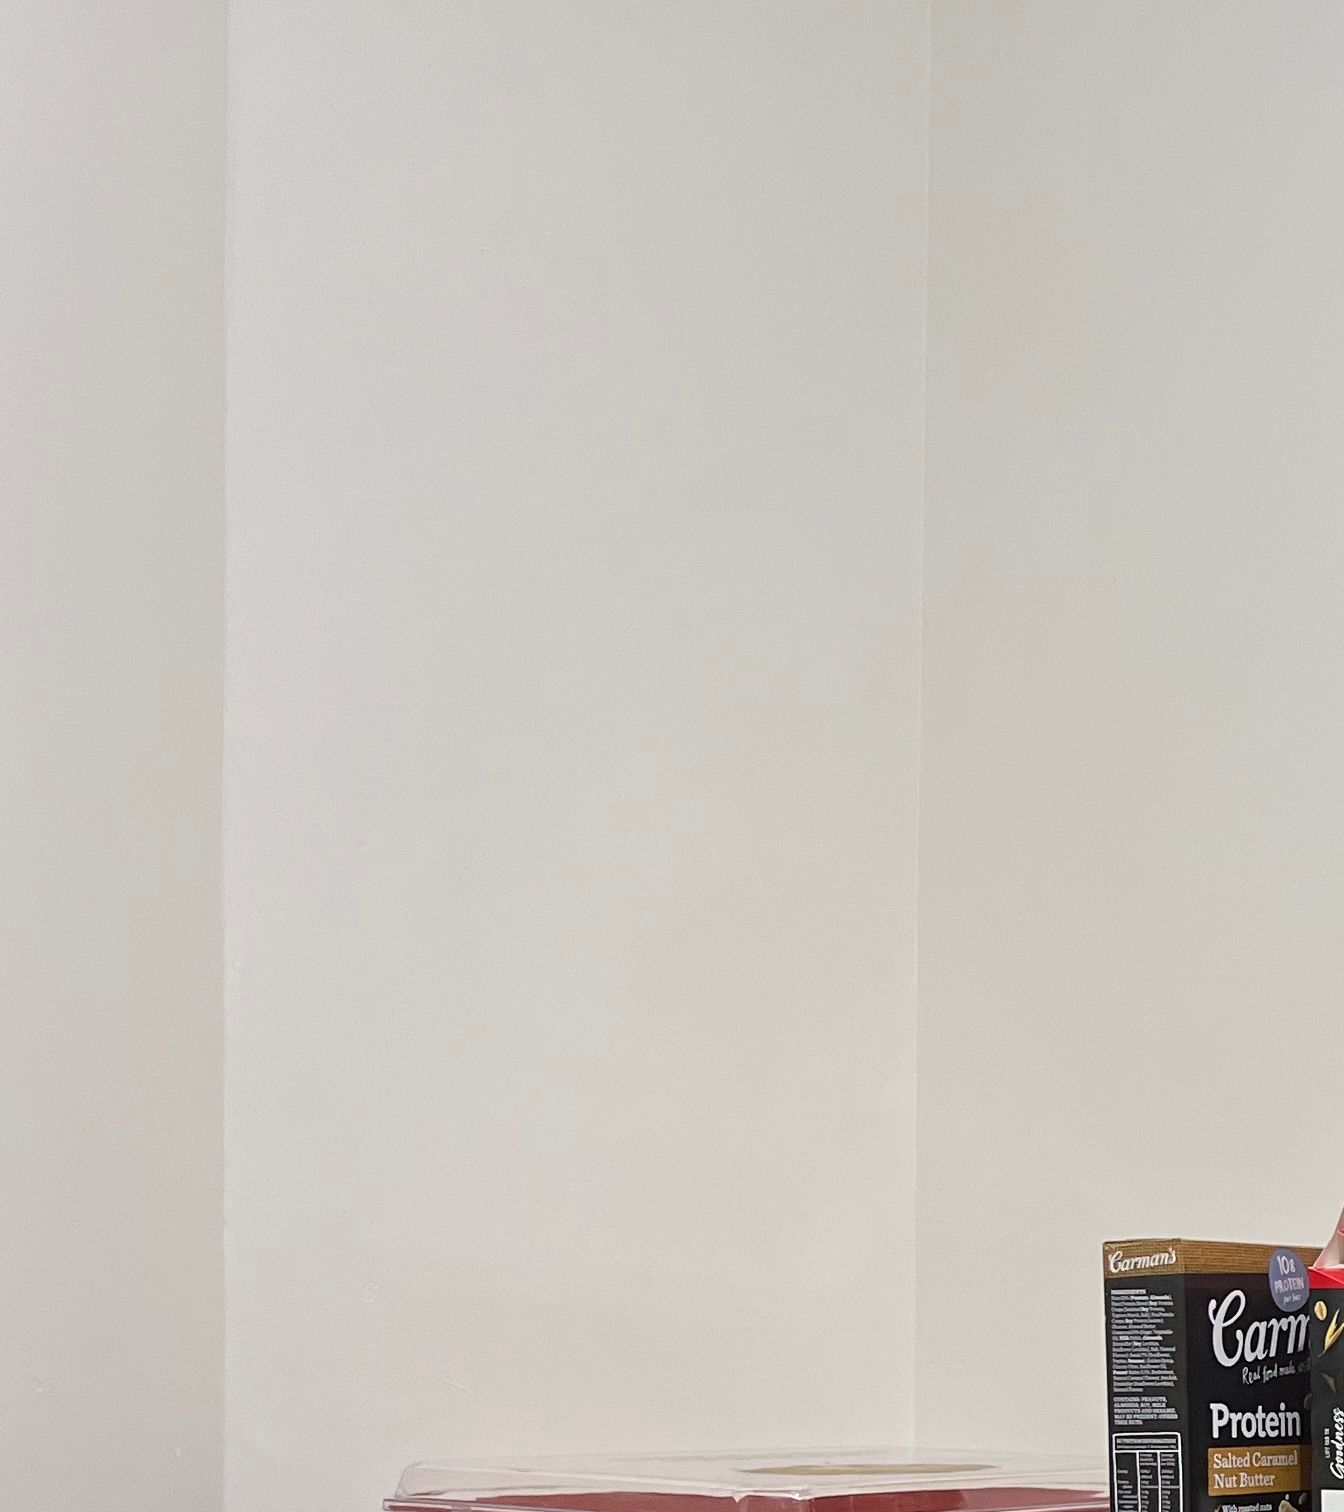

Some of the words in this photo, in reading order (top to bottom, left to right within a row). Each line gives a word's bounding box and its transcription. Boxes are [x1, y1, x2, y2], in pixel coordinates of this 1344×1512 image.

[1108, 1248, 1176, 1273] Carman's
[1274, 1278, 1304, 1292] PROTEIN
[1243, 1366, 1261, 1384] Real
[1210, 1402, 1301, 1439] Protein
[1213, 1452, 1250, 1469] Salted
[1252, 1450, 1298, 1467] Caramel
[1213, 1473, 1238, 1489] Nut
[1239, 1472, 1276, 1488] Butter
